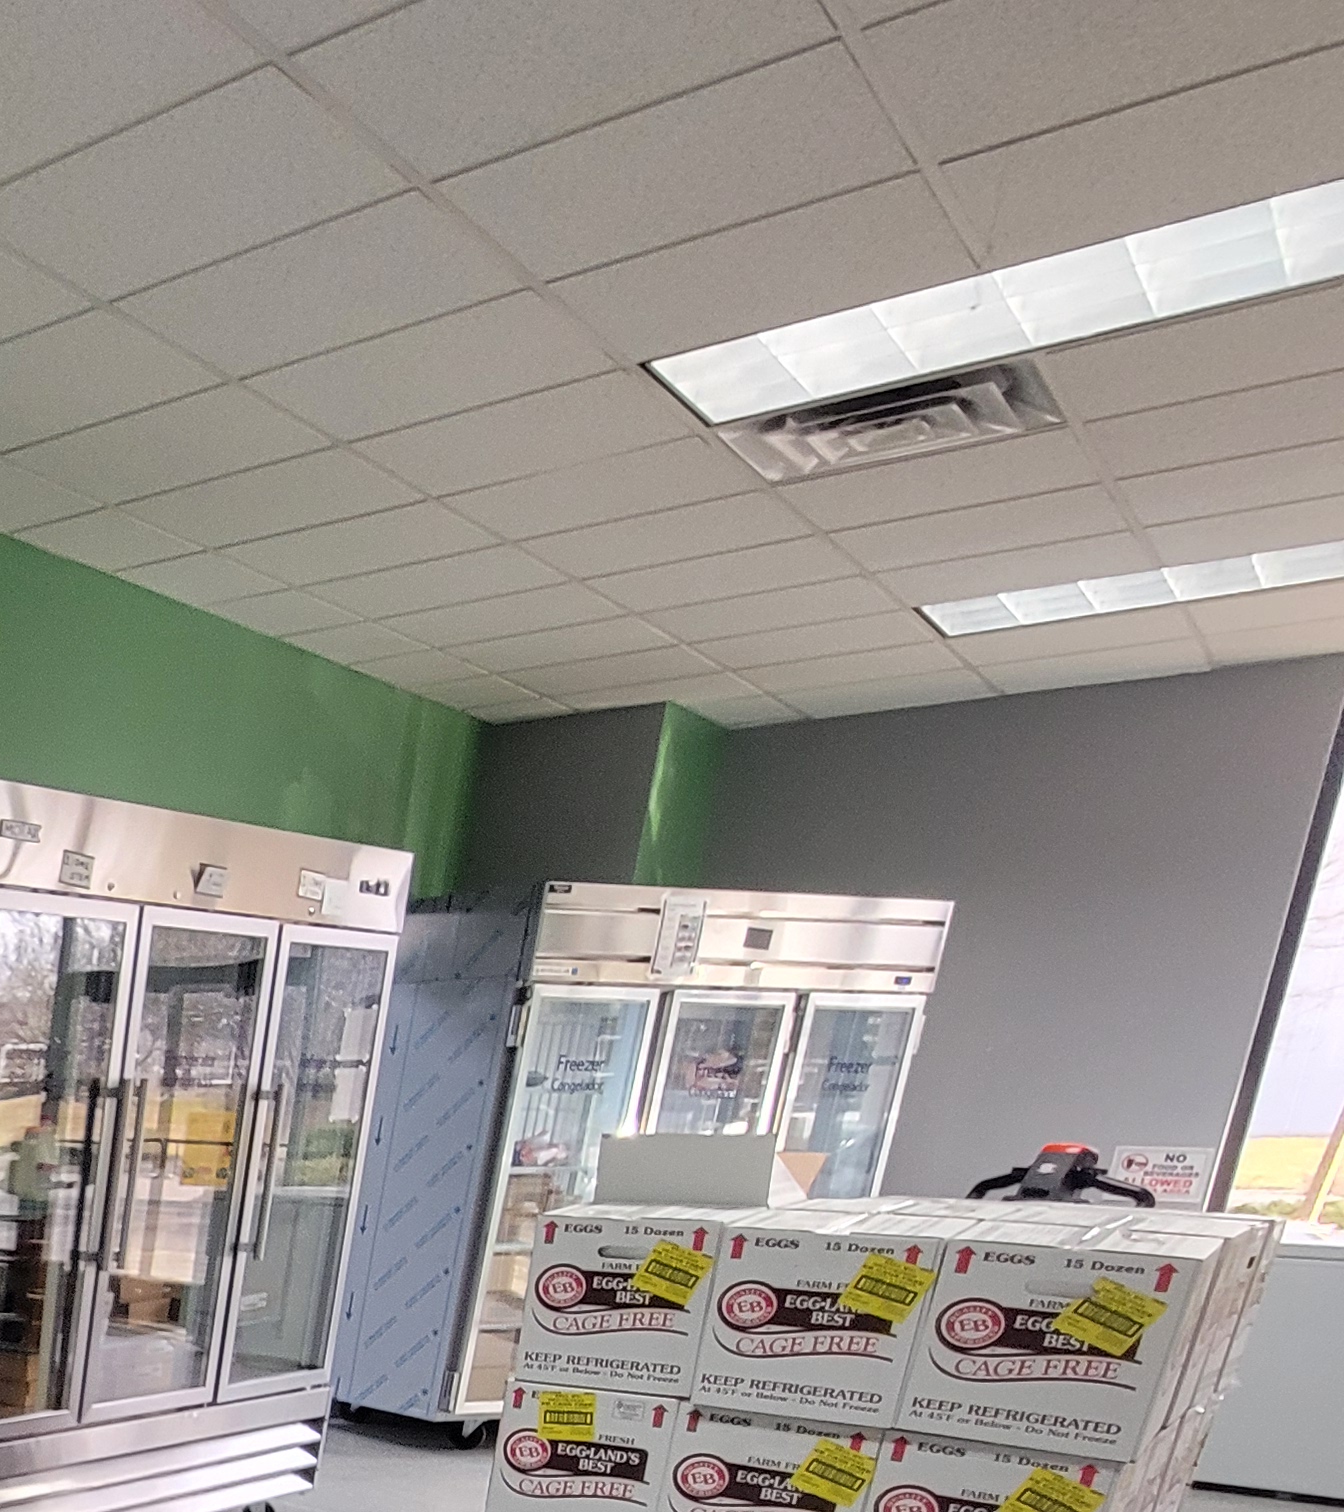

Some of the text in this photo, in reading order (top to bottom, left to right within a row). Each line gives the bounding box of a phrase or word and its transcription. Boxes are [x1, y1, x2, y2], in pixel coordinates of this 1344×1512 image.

[556, 1055, 606, 1073] Freezer
[695, 1060, 743, 1080] Freezer
[827, 1055, 873, 1073] Freezer
[551, 1078, 605, 1094] Congelador
[1164, 1153, 1187, 1163] NO
[564, 1224, 603, 1234] EGGS
[624, 1226, 638, 1234] 15
[754, 1237, 895, 1255] EGGS 15 Dozen
[602, 1262, 632, 1270] FARM
[983, 1252, 1146, 1275] EGGS 15 Dozen
[552, 1281, 575, 1294] EB
[796, 1279, 833, 1290] FARM
[616, 1291, 653, 1305] BEST
[736, 1300, 763, 1313] EB
[553, 1312, 675, 1330] CAGE FREE
[811, 1311, 856, 1327] BEST
[958, 1318, 989, 1332] EB
[736, 1336, 879, 1354] CAGE FREE
[524, 1351, 681, 1375] KEEP REFRIGERATED
[954, 1358, 1122, 1380] CAGE FREE
[573, 1367, 601, 1375] Below
[627, 1371, 643, 1380] Not
[647, 1374, 679, 1383] Freeze
[701, 1373, 882, 1404] KEEP REFRIGERATED
[756, 1391, 788, 1402] Below
[800, 1396, 816, 1405] Do
[820, 1399, 838, 1407] Not
[842, 1401, 879, 1413] Freeze
[912, 1397, 1122, 1436] KEEP REFRIGERATED
[709, 1413, 751, 1427] EGGS
[796, 1425, 841, 1439] Dozen
[909, 1410, 924, 1418] At
[974, 1416, 1012, 1431] Below
[1025, 1425, 1044, 1434] Do
[1047, 1427, 1070, 1438] Not
[1075, 1430, 1117, 1445] Freeze
[519, 1446, 540, 1458] EB
[917, 1441, 1069, 1473] EGGS 15 Dozen
[578, 1460, 615, 1474] BEST
[747, 1456, 782, 1470] FARM
[691, 1471, 716, 1486] EB
[519, 1479, 635, 1498] CAGE FREE
[760, 1487, 803, 1505] BEST
[961, 1488, 1000, 1501] FARM
